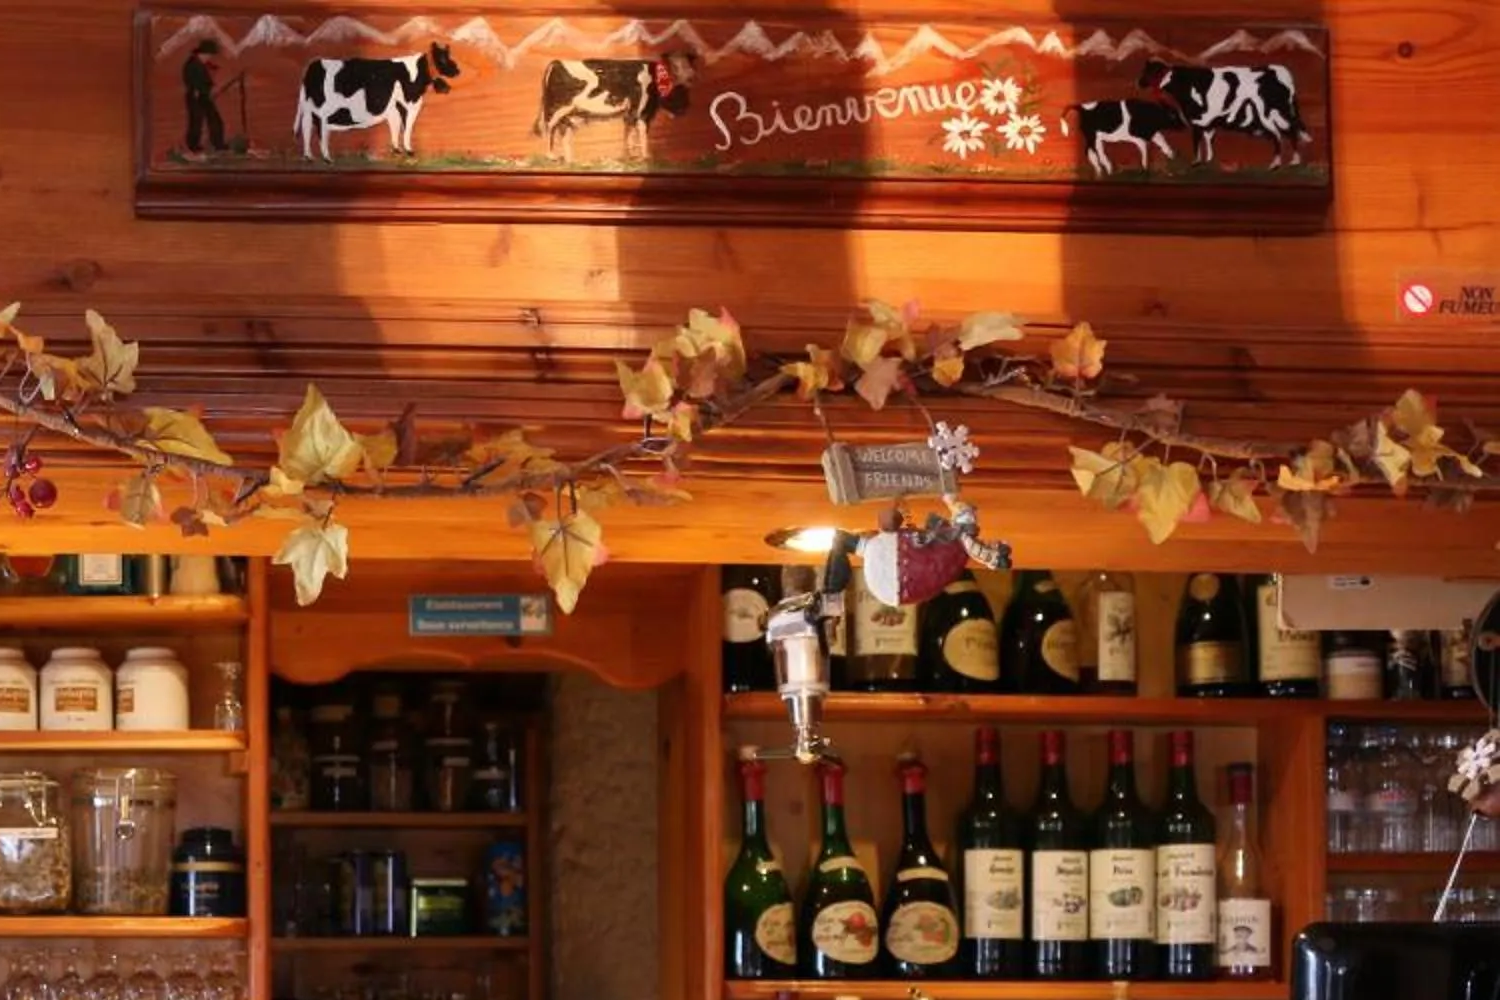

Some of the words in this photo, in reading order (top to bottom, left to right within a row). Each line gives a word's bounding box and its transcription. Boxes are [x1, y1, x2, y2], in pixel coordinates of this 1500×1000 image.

[709, 81, 978, 151] Bienvenue
[1460, 285, 1496, 300] NON
[1438, 299, 1500, 315] FUMEU
[859, 447, 932, 464] WELCOME
[865, 472, 933, 488] FRIENDS
